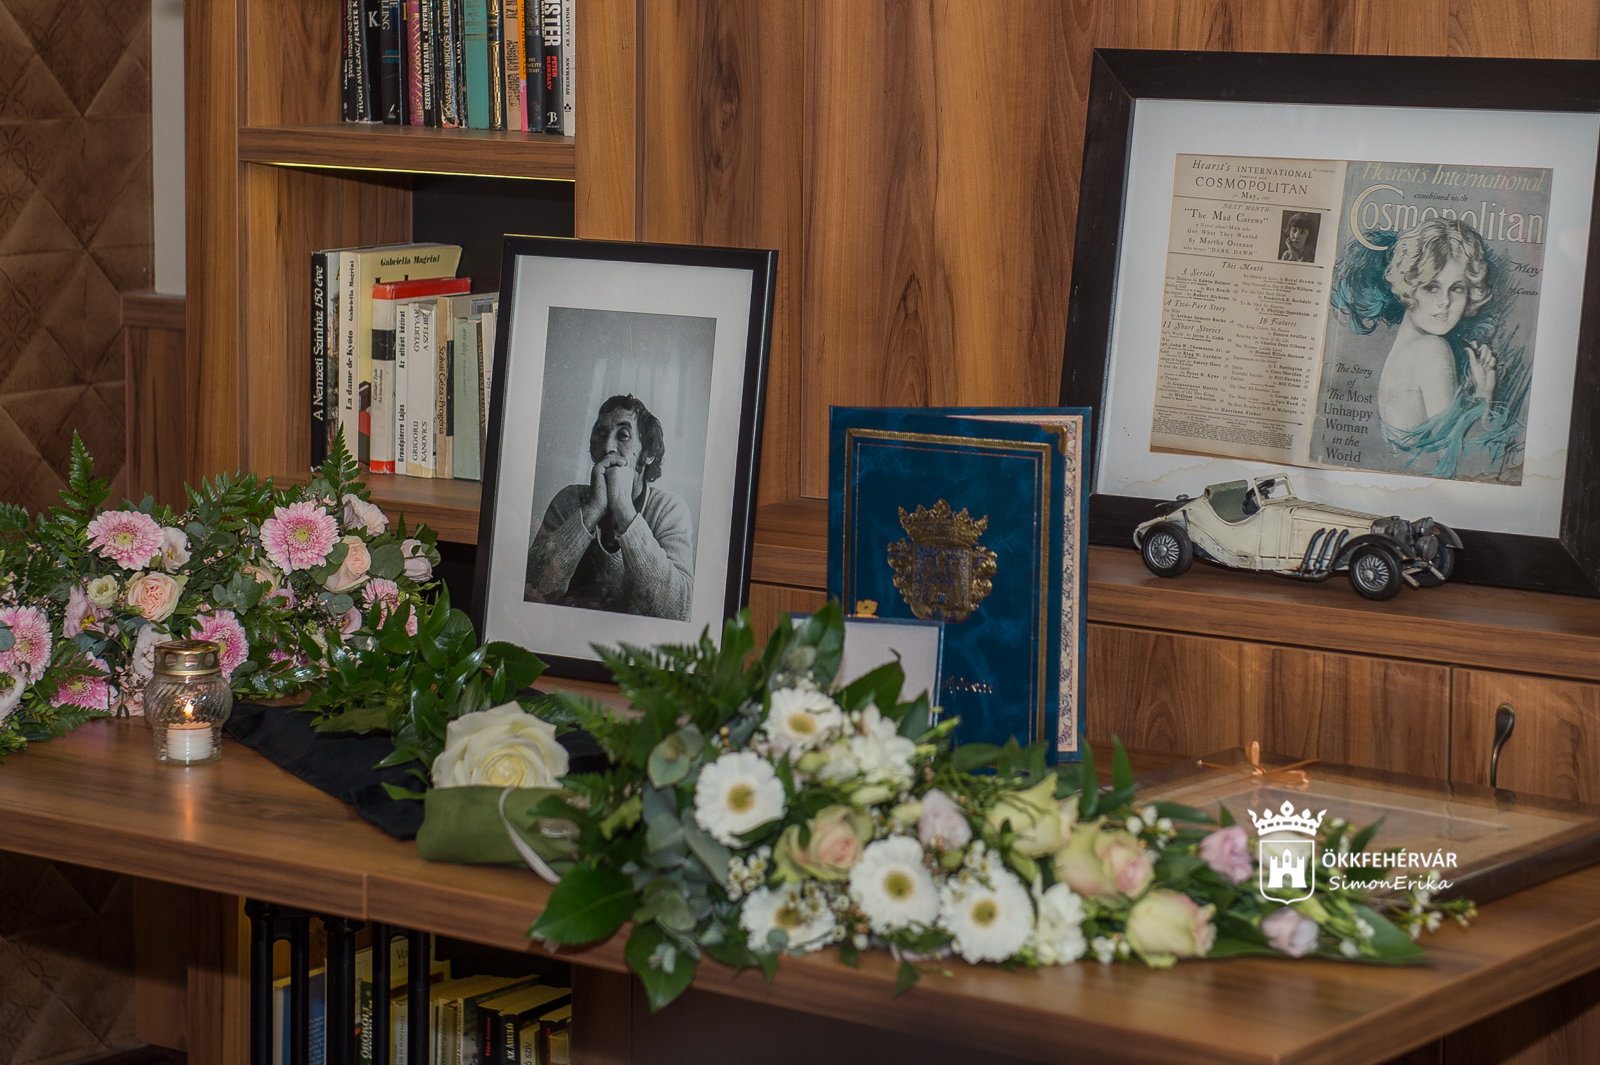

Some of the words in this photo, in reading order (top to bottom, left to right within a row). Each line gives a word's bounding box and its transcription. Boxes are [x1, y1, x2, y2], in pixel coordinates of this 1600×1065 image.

[443, 35, 451, 67] MIKLÓS
[423, 73, 431, 110] SZEGVÁRI
[1192, 160, 1231, 172] Hearst's
[1237, 166, 1313, 179] INTERNATIONAL
[1195, 176, 1308, 195] COSMOPOLITAN
[1432, 165, 1546, 192] International
[1241, 191, 1259, 200] May,
[1414, 192, 1450, 201] combined
[1451, 193, 1468, 202] with
[1212, 210, 1230, 221] Mad
[1200, 237, 1224, 245] Martha
[1227, 240, 1254, 248] Ostenso
[380, 256, 411, 267] Gabriella
[413, 255, 440, 264] Magrini
[1240, 263, 1264, 272] Month
[1190, 268, 1216, 277] Serials
[1508, 262, 1543, 278] May
[315, 288, 323, 308] 150
[1175, 300, 1207, 309] Two-Part
[1209, 304, 1226, 313] Story
[1163, 320, 1171, 328] 11
[1174, 322, 1194, 330] Short
[1196, 325, 1221, 334] Stories
[1260, 317, 1267, 325] 10
[1270, 318, 1297, 327] Features
[314, 310, 323, 355] Színház
[346, 359, 353, 369] de
[399, 361, 405, 369] Az
[1336, 363, 1350, 373] The
[1351, 365, 1373, 378] Story
[313, 359, 323, 406] Nemzeti
[1347, 377, 1358, 388] of
[1328, 388, 1344, 400] The
[1347, 390, 1373, 403] Most
[346, 398, 353, 411] La
[313, 410, 323, 421] A
[437, 400, 445, 435] Progéria
[1324, 403, 1373, 422] Unhappy
[1326, 418, 1368, 434] Woman
[420, 421, 428, 462] KANOVICS
[1332, 436, 1342, 445] in
[1344, 436, 1360, 447] the
[1326, 447, 1361, 462] World
[504, 1022, 515, 1049] ÁRULÓ
[506, 1050, 515, 1061] AZ
